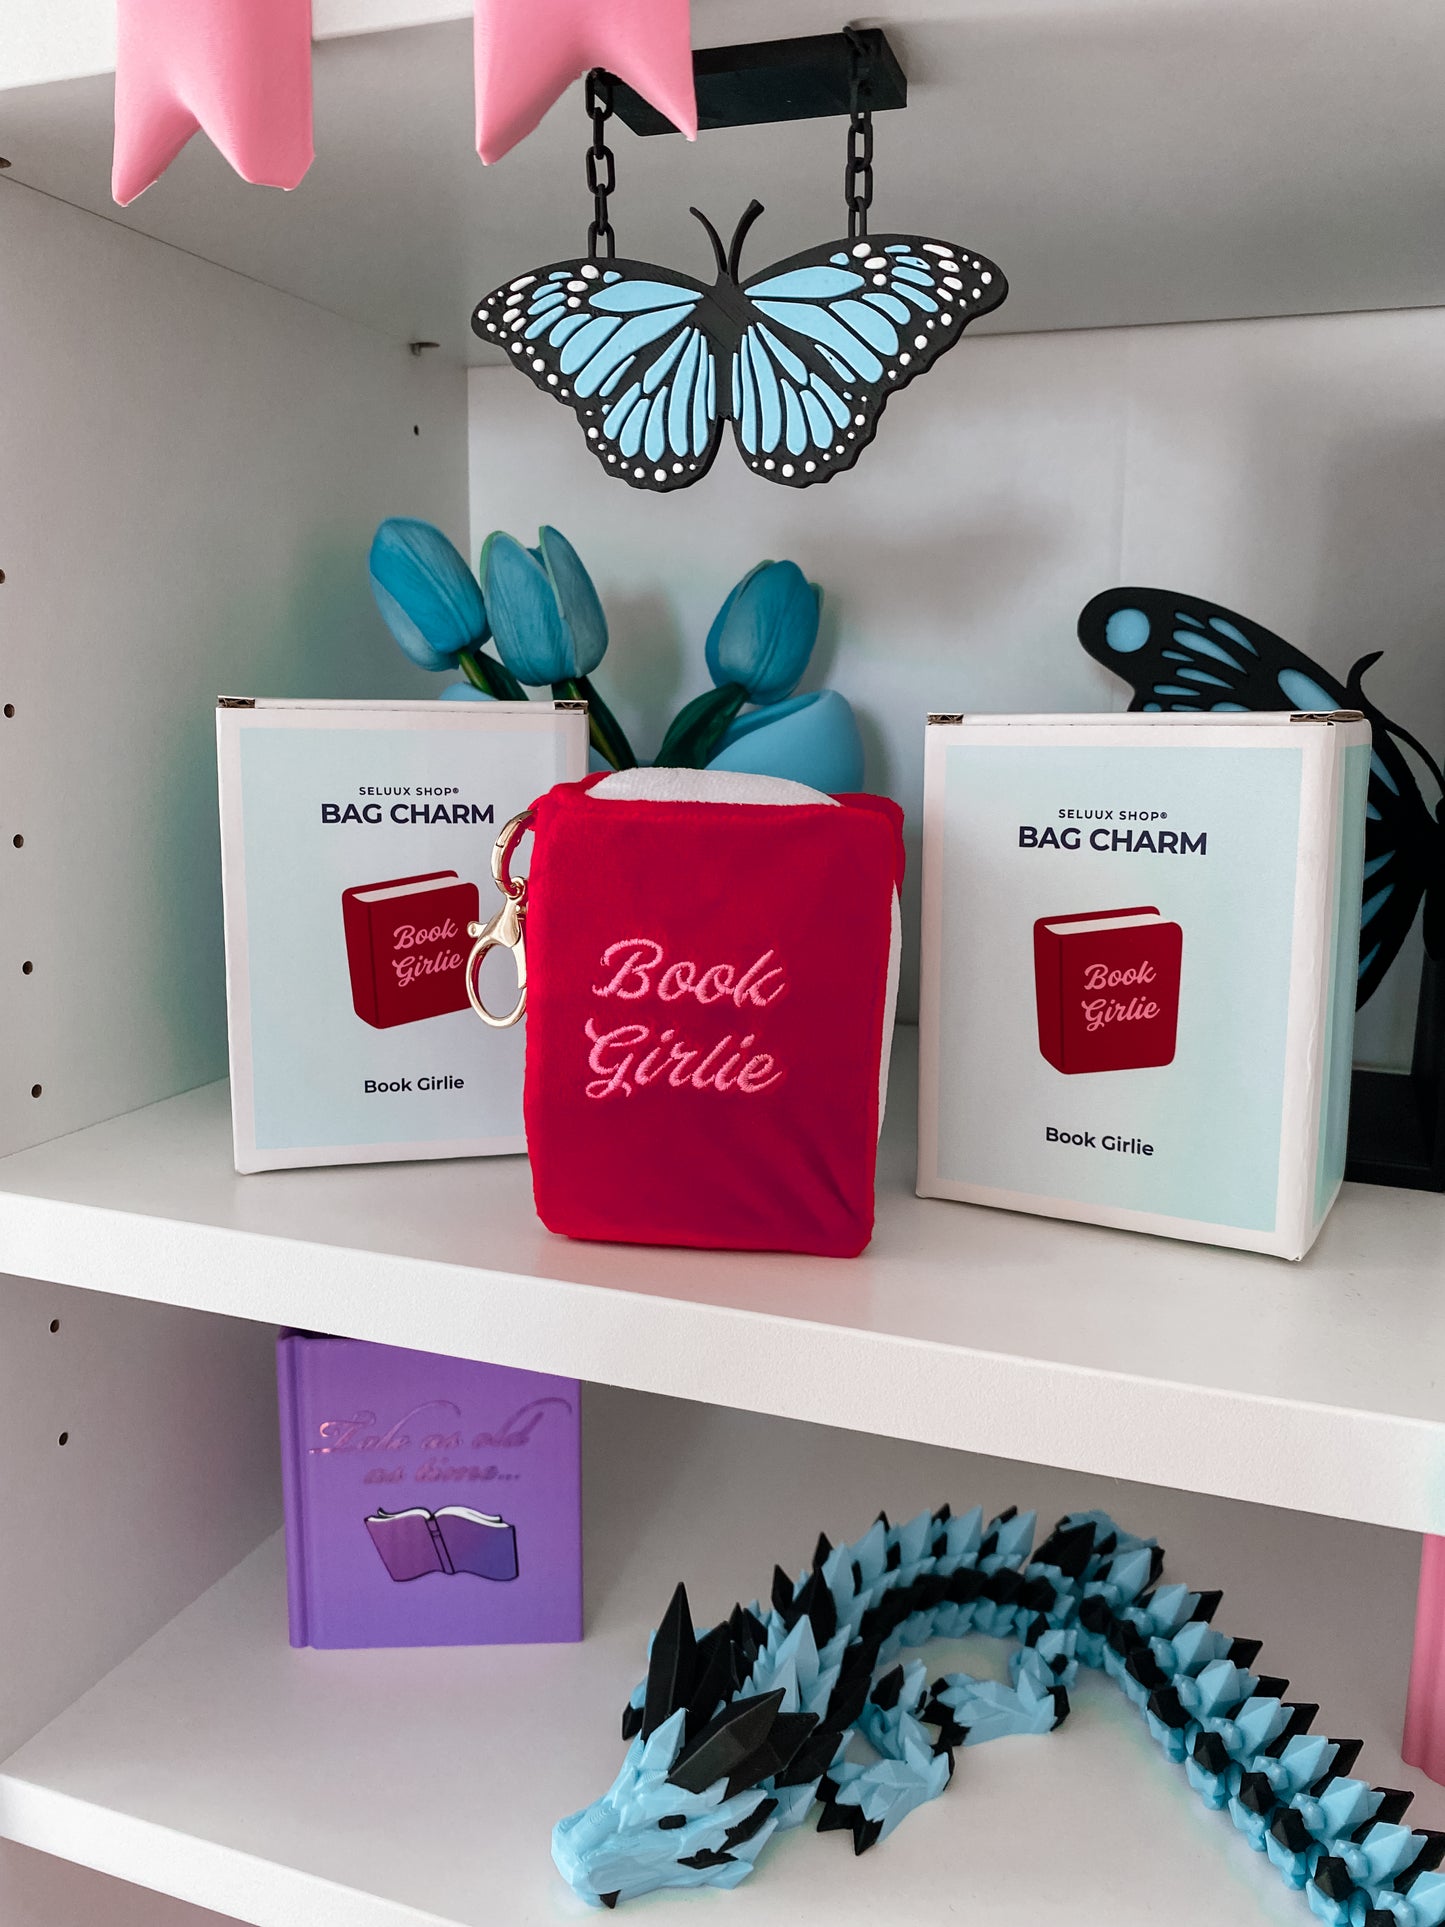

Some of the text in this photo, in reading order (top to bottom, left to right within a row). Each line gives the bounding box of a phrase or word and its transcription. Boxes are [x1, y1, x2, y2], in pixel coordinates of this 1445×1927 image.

[359, 786, 411, 796] SELUUX
[321, 803, 495, 824] BAG CHARM
[1058, 808, 1114, 820] SELUUX
[1018, 825, 1208, 856] BAG CHARM
[393, 918, 459, 950] Book
[391, 949, 464, 987] Girlie
[591, 937, 786, 1008] Book
[1084, 960, 1157, 990] Book
[1081, 996, 1161, 1032] Girlie
[584, 1017, 783, 1099] Girlie
[364, 1075, 465, 1094] Book Girlie
[1045, 1126, 1154, 1156] Book Girlie
